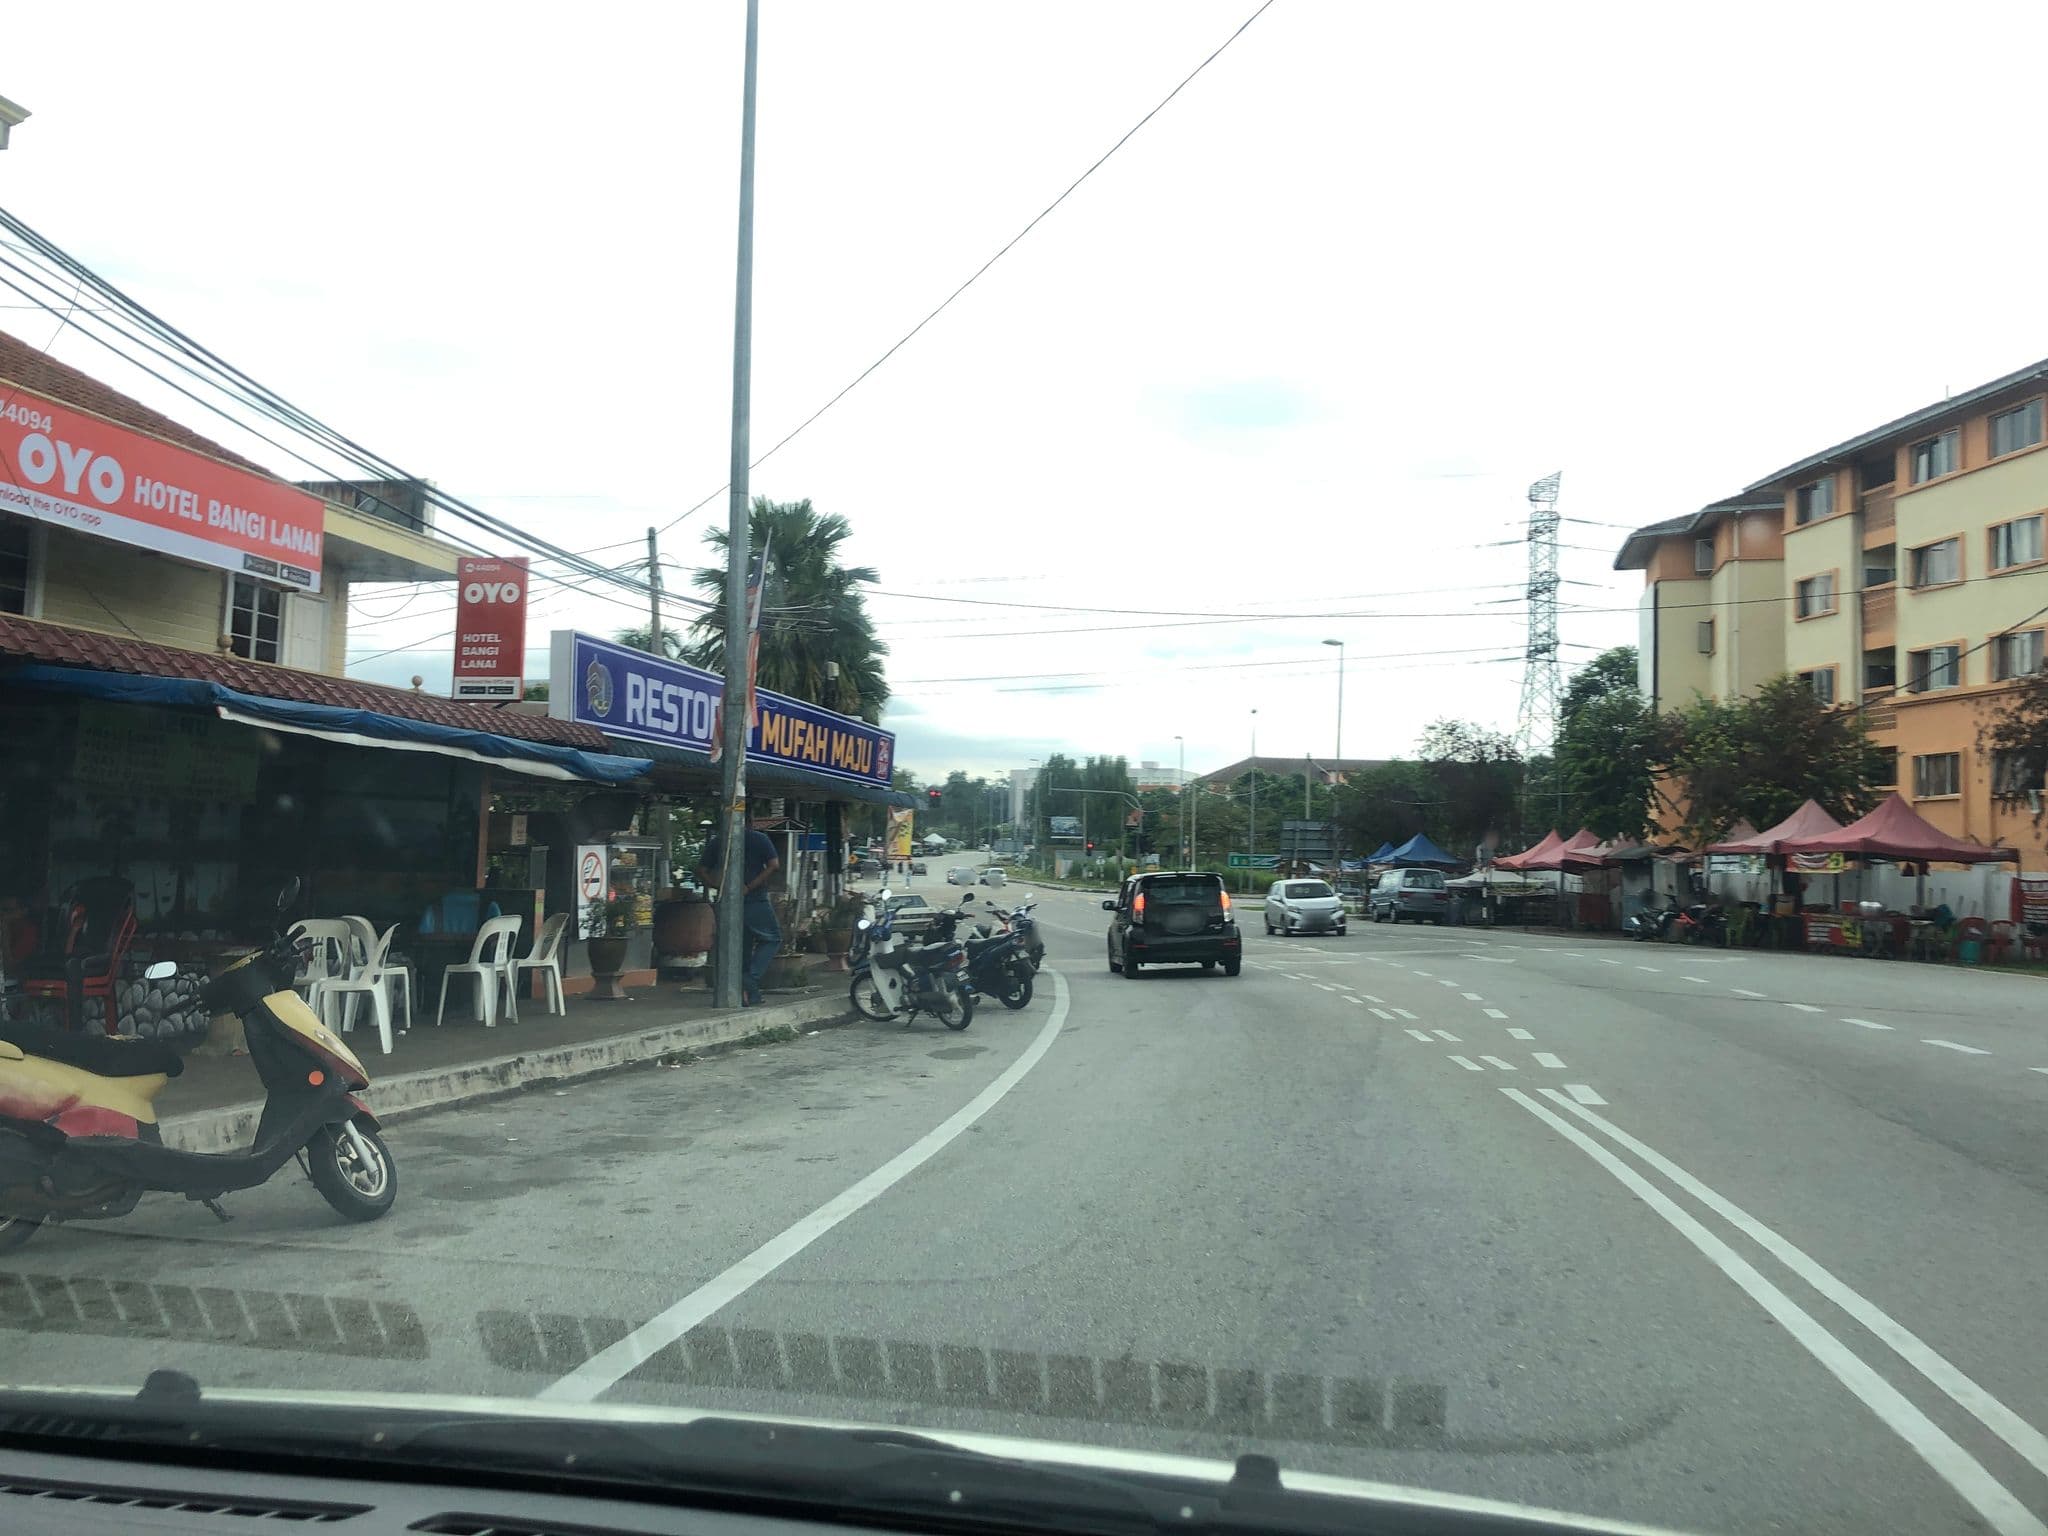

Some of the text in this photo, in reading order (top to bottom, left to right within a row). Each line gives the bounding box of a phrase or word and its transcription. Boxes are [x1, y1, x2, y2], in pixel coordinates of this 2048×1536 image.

[18, 432, 125, 504] OYO
[134, 475, 320, 557] HOTEL BANGI LANAI
[464, 582, 521, 604] OYO
[463, 634, 502, 643] HOTEL
[462, 646, 499, 656] BANGI
[461, 660, 497, 669] LANAI
[761, 710, 829, 764] MUFAH
[831, 730, 872, 774] MAJU
